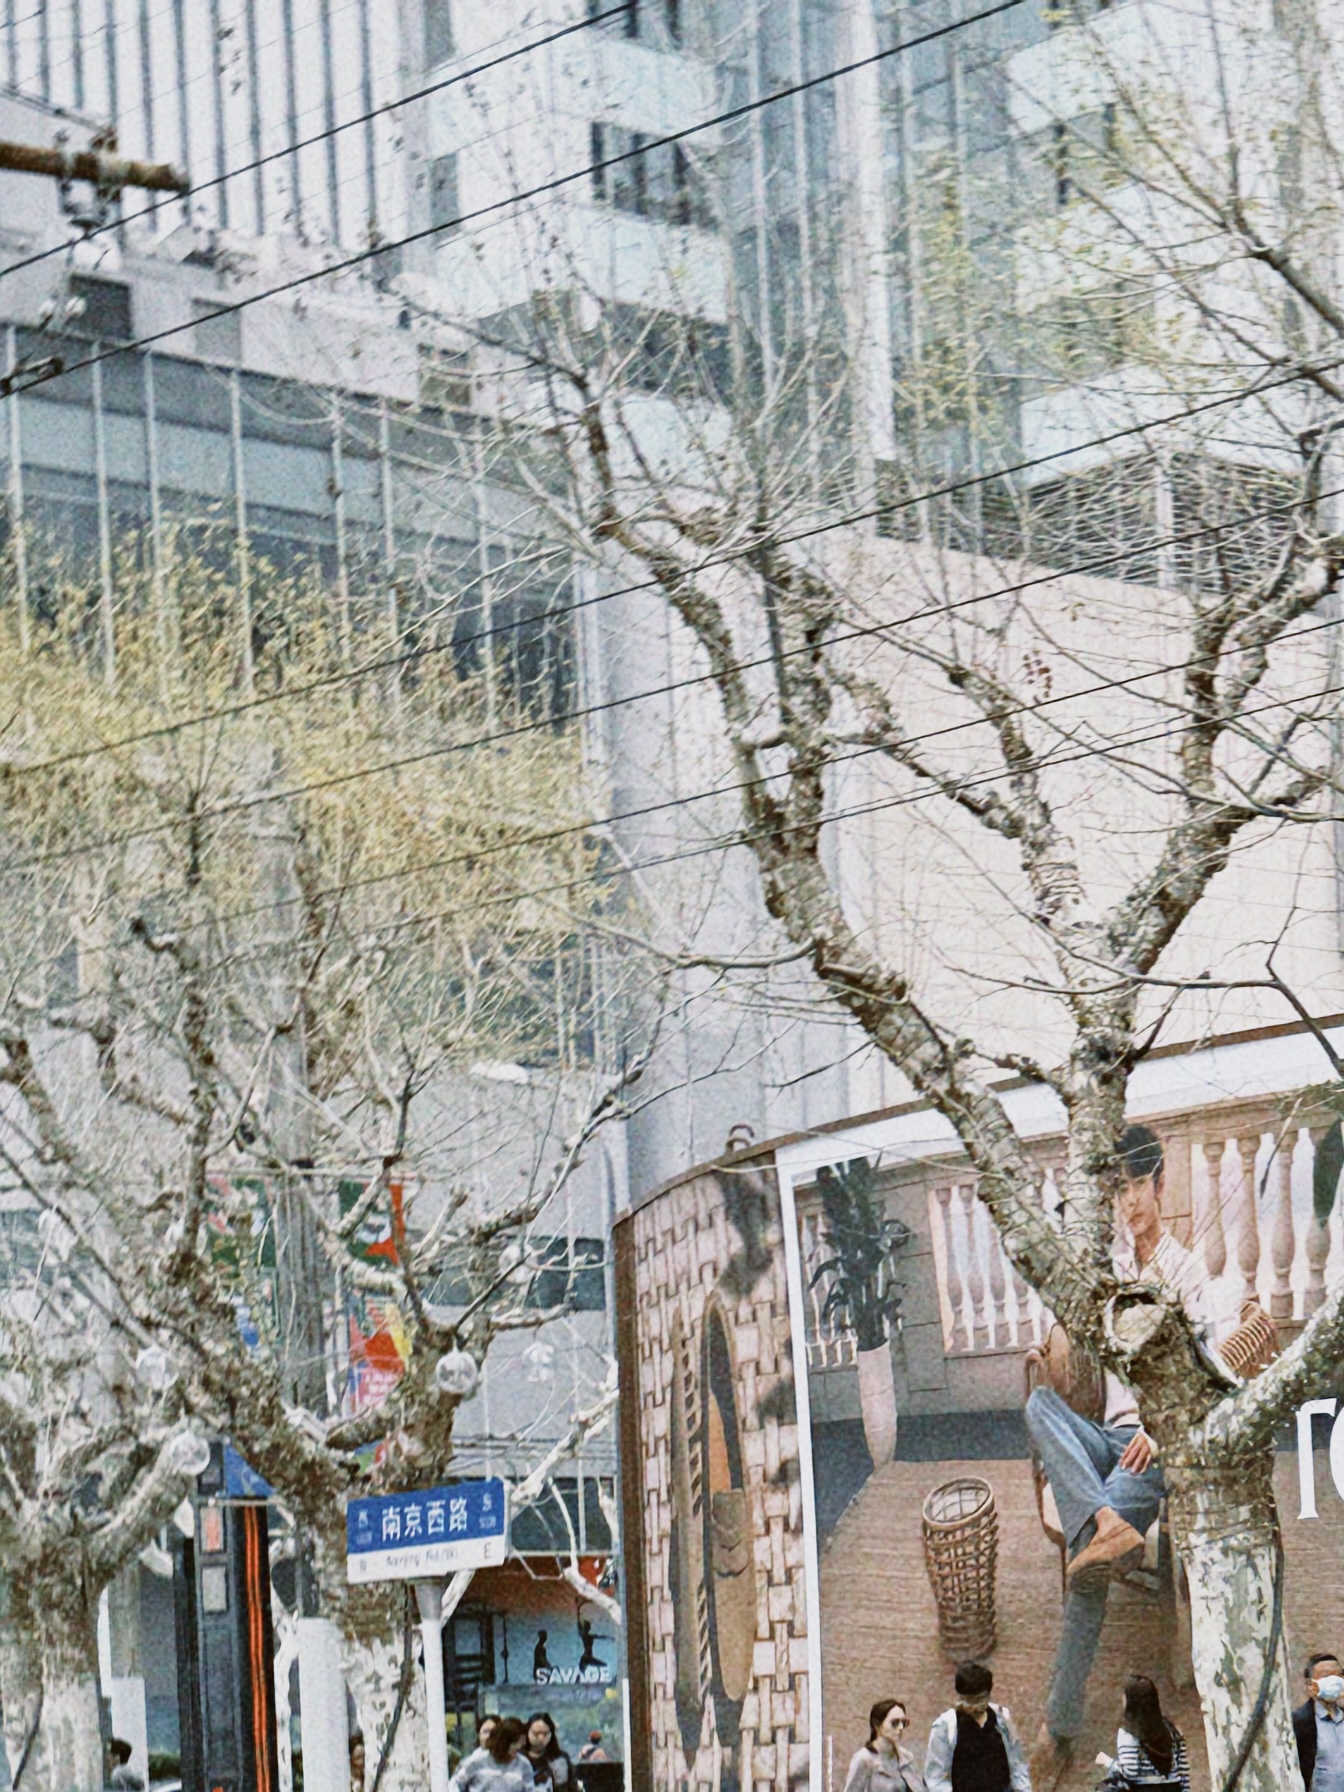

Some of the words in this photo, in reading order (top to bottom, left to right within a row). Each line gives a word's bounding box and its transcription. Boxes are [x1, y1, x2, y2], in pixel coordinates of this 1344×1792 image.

[382, 1496, 467, 1542] 南京西路
[536, 1664, 611, 1685] SAVAGE
